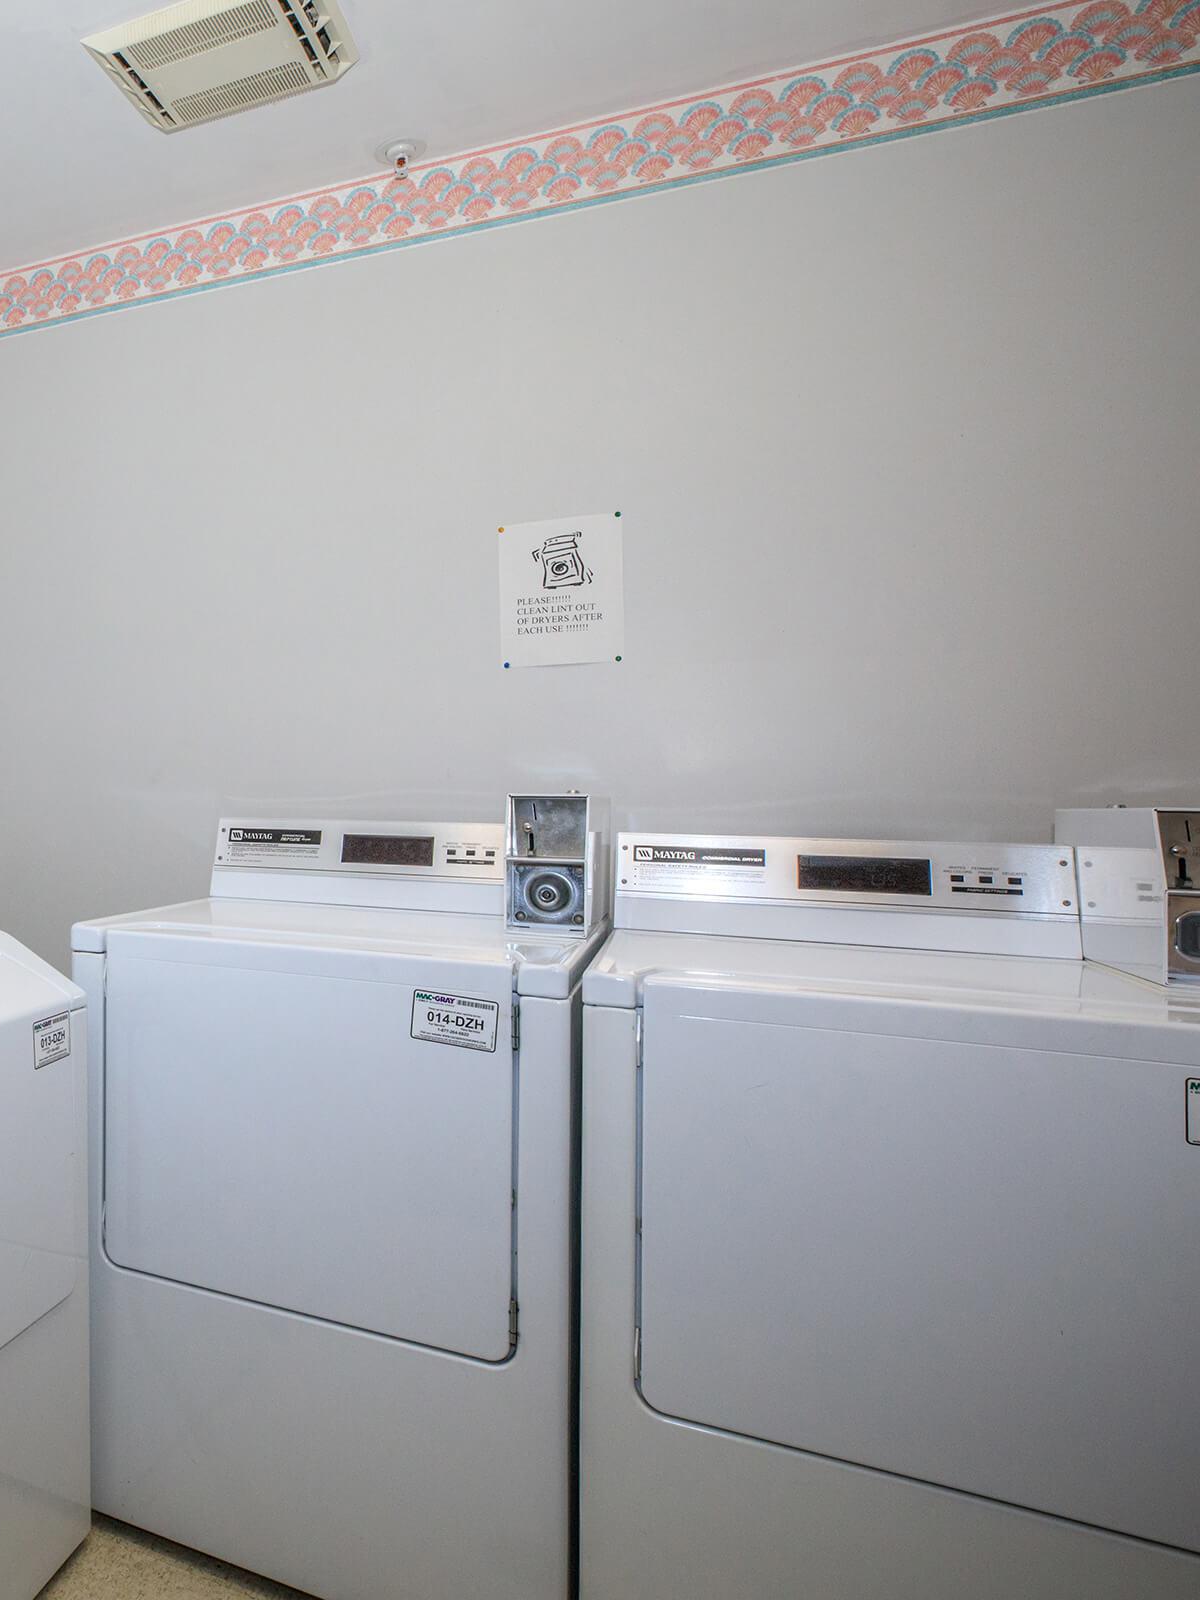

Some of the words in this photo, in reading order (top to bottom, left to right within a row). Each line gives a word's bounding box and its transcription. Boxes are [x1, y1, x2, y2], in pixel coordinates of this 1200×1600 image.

[517, 606, 548, 615] CLEAN
[551, 605, 573, 613] LINT
[575, 603, 596, 611] OUT
[532, 615, 569, 624] DRYERS
[572, 613, 603, 622] AFTER
[517, 626, 542, 635] EACH
[546, 625, 563, 633] USE
[654, 851, 695, 860] MAYTAG
[427, 1011, 484, 1031] 014-DZH
[41, 1030, 66, 1049] 013-DZH
